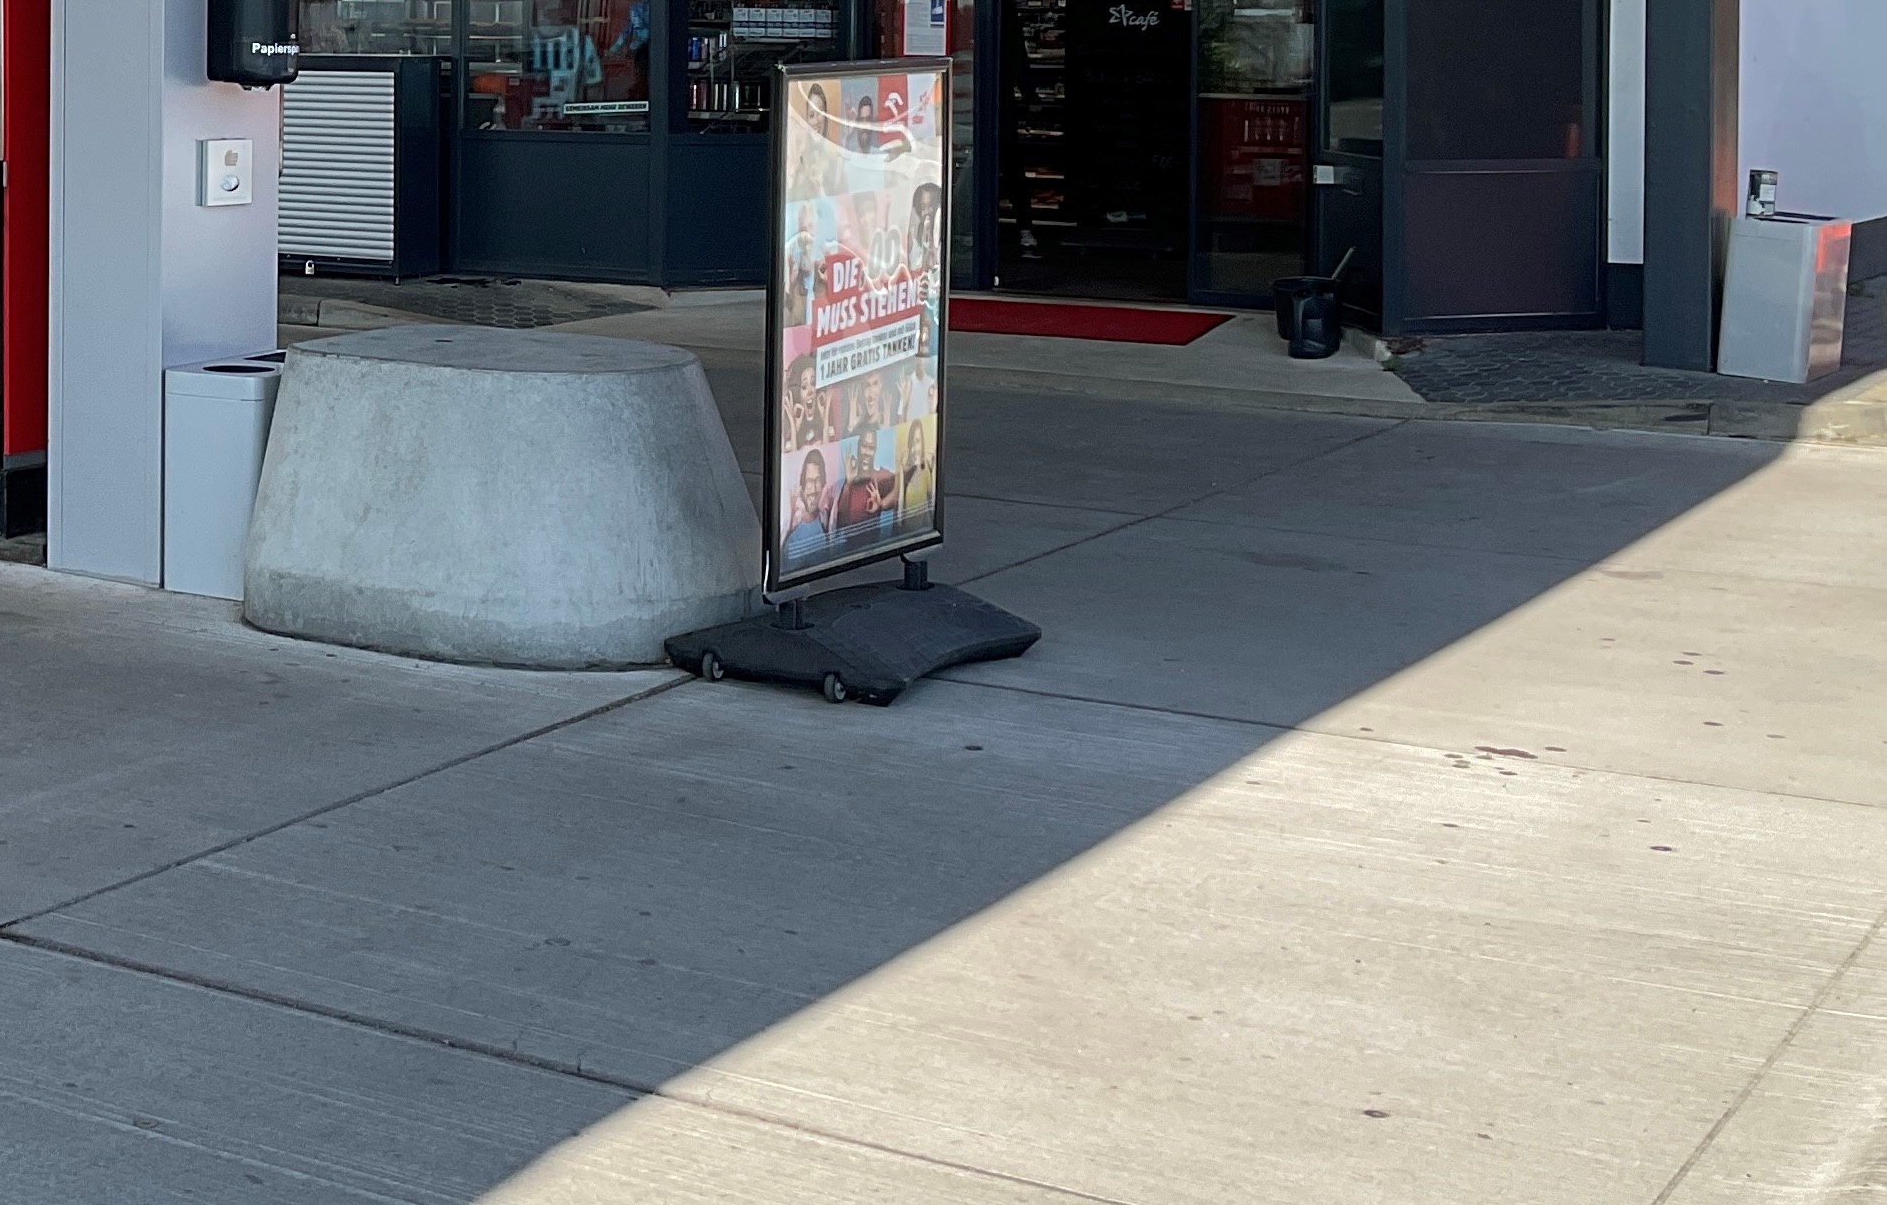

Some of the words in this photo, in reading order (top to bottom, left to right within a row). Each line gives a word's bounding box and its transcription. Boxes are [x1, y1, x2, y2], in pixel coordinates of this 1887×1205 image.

[1128, 11, 1160, 31] café
[833, 257, 860, 293] DIE
[816, 296, 857, 338] MUSS
[820, 363, 825, 381] 1
[826, 356, 849, 378] JAHR
[850, 345, 881, 371] GRATIS
